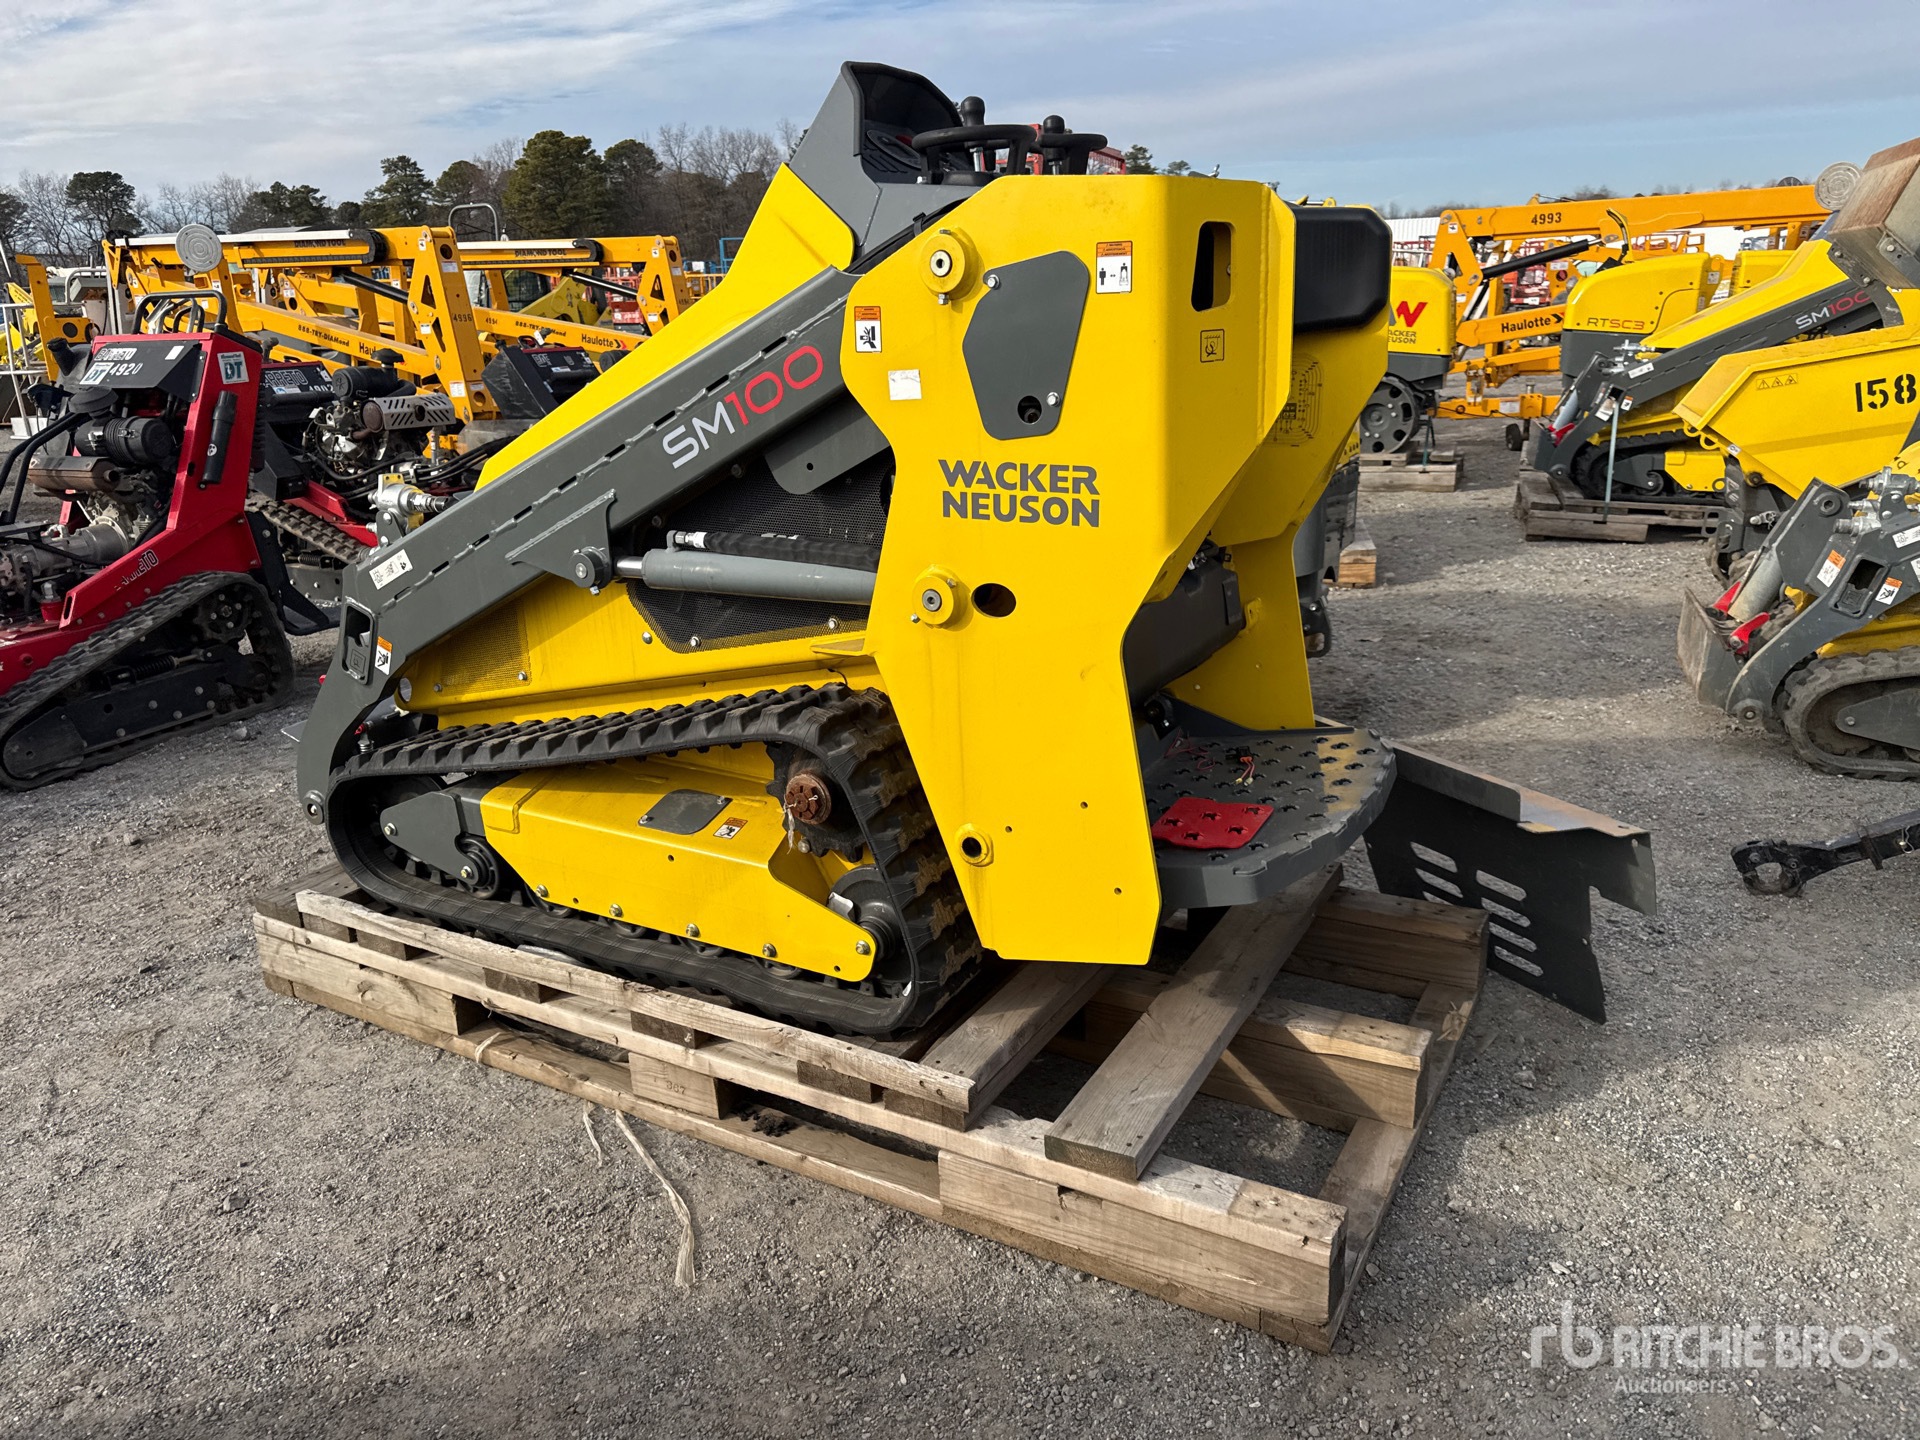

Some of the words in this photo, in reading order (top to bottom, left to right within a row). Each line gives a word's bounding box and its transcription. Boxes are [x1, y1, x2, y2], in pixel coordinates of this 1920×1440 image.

[1531, 212, 1562, 225] 4993
[453, 313, 473, 322] 4996
[1501, 313, 1551, 333] Haulotte
[581, 333, 614, 348] Haulotte
[1388, 329, 1417, 338] ACKER
[1388, 336, 1417, 344] EUSON
[109, 362, 143, 376] 4920
[1854, 373, 1917, 412] 158
[662, 345, 824, 469] SM100
[938, 459, 1100, 496] WACKER
[942, 490, 1100, 528] NEUSON
